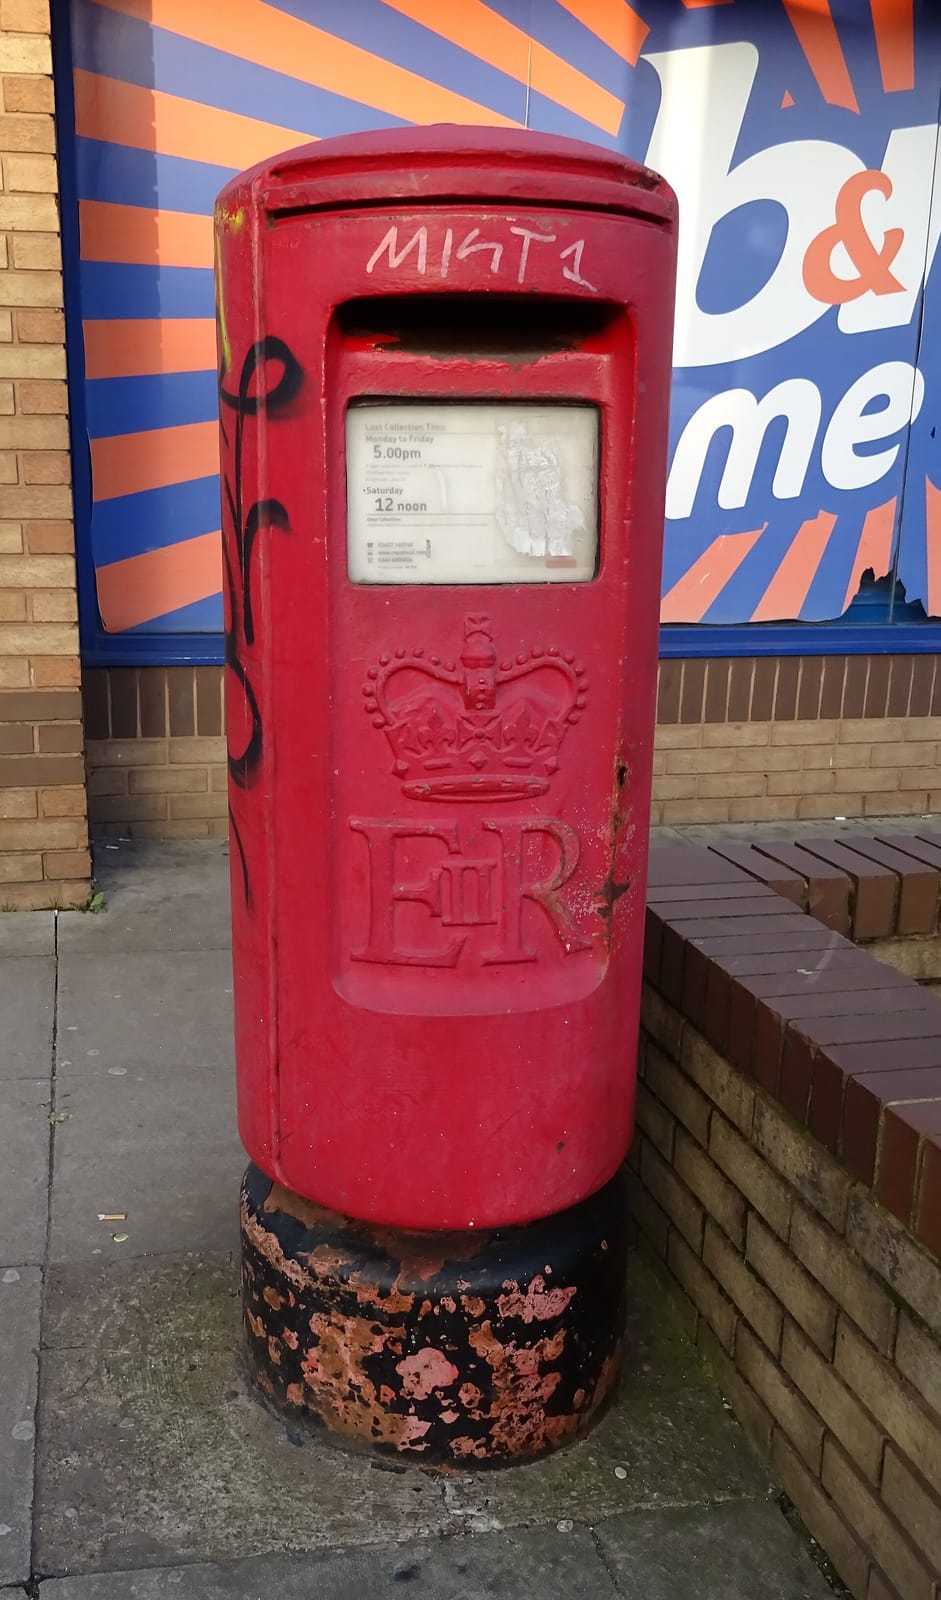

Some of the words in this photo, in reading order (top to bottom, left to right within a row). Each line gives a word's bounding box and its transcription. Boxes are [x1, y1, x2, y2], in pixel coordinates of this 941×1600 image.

[365, 423, 382, 431] Last
[385, 423, 424, 431] Collection
[365, 435, 397, 444] Monday
[399, 435, 407, 443] to
[409, 435, 434, 444] Friday
[373, 444, 421, 460] 5.00pm
[366, 486, 403, 495] Saturday
[375, 498, 394, 511] 12
[397, 503, 427, 511] noon
